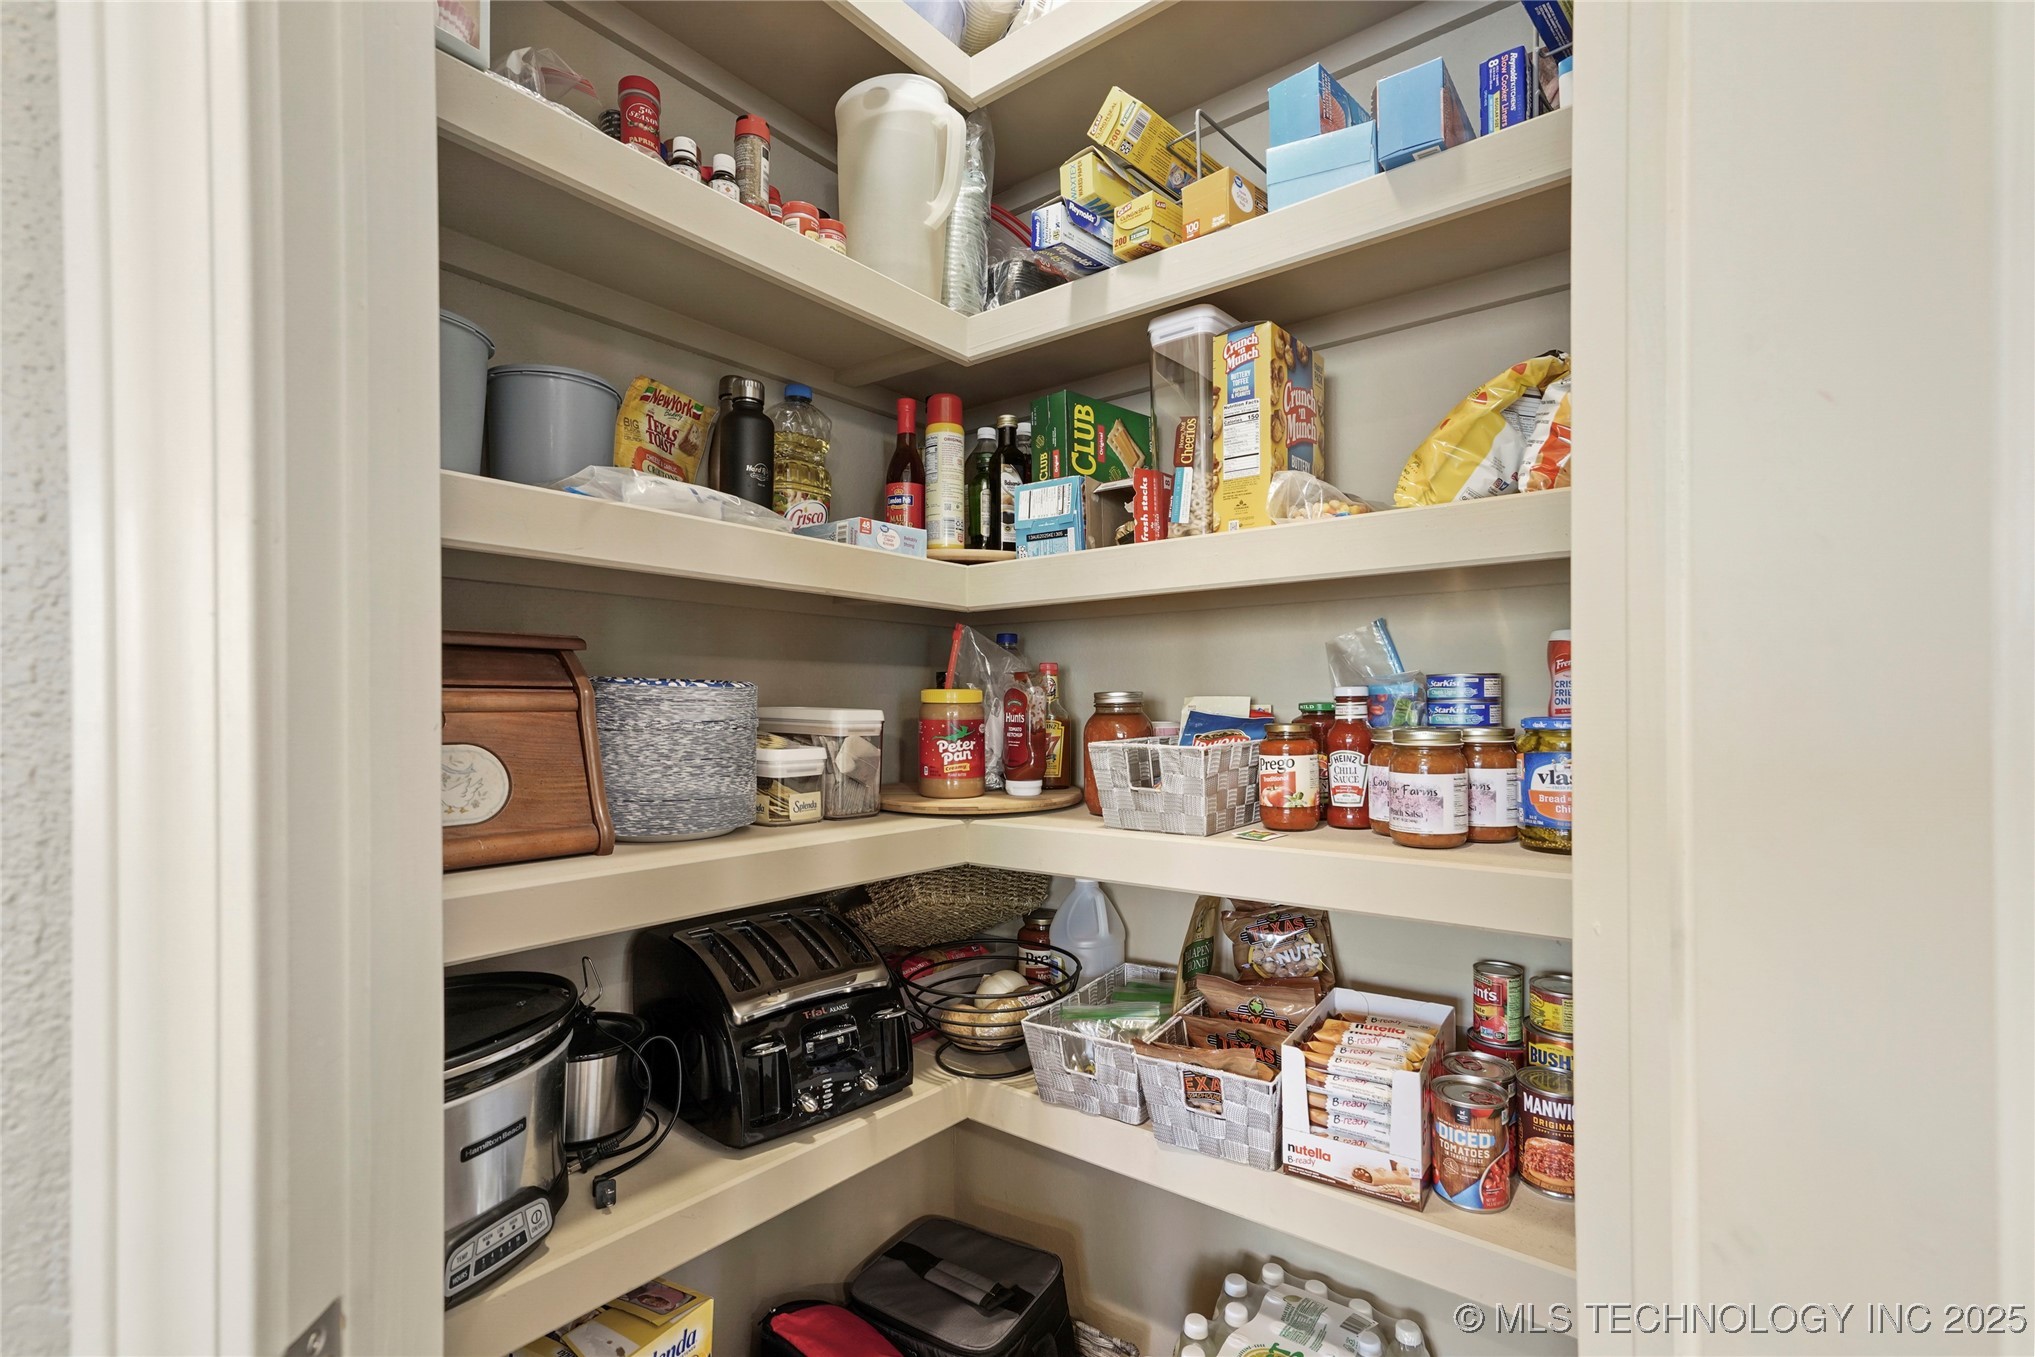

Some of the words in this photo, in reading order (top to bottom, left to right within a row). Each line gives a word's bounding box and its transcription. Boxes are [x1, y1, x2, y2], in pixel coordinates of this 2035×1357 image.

[1488, 58, 1498, 68] 8
[1501, 54, 1509, 73] Slow
[1501, 75, 1509, 102] Cooker
[629, 110, 658, 126] SEASON
[1501, 102, 1509, 127] Liners
[1092, 115, 1102, 135] GLAD
[1109, 129, 1121, 146] 200
[1069, 202, 1095, 223] Reynolds
[1117, 202, 1132, 216] GLAD
[1186, 222, 1198, 234] 100
[1114, 236, 1127, 248] 200
[1224, 333, 1258, 359] Crunch
[1226, 347, 1258, 373] Munch
[1232, 377, 1250, 386] TOFFEE
[1284, 382, 1316, 413] Crunch
[624, 417, 640, 428] BIG
[646, 413, 679, 442] TEXAS
[1286, 413, 1316, 444] Munch
[646, 430, 676, 456] TOAST
[1071, 403, 1097, 476] CLUB
[1180, 418, 1197, 464] Cheerios
[746, 464, 762, 472] Hard
[1039, 452, 1048, 481] CLUB
[1292, 454, 1310, 473] BUTTERY
[1140, 477, 1148, 511] stacks
[790, 508, 824, 529] Crisco
[862, 521, 870, 529] 48
[1140, 514, 1149, 542] fresh
[1430, 680, 1464, 688] StarKist
[1554, 698, 1571, 706] ONI
[1434, 706, 1468, 714] StarKist
[936, 740, 976, 753] Peter
[1260, 758, 1296, 774] Prego
[1334, 754, 1358, 764] HEINZ
[946, 764, 967, 772] Creamy
[1334, 766, 1358, 775] CHILI
[1334, 776, 1360, 784] SAUCE
[1401, 784, 1438, 797] Farms
[1538, 794, 1566, 803] Bread
[792, 800, 818, 813] Splenda
[1404, 809, 1424, 818] Salsa
[1556, 806, 1572, 814] Chi
[1248, 918, 1305, 941] TEXAS
[1026, 952, 1050, 966] Pre
[1188, 956, 1210, 973] HONEY
[1356, 1024, 1406, 1034] nutella
[1348, 1036, 1381, 1046] B-ready
[1340, 1047, 1375, 1056] B-ready
[1530, 1046, 1573, 1070] BUSH'
[1335, 1057, 1371, 1067] B-ready
[1332, 1097, 1368, 1110] B-ready
[1333, 1114, 1369, 1127] B-ready
[1533, 1116, 1574, 1132] ORIGINA
[464, 1136, 502, 1158] Hamilton
[502, 1122, 524, 1139] Beach
[1438, 1121, 1491, 1149] DICED
[1288, 1143, 1332, 1162] nutella
[1439, 1138, 1490, 1158] TOMATOES
[1288, 1156, 1316, 1166] B-ready
[457, 1252, 469, 1264] TEMP
[452, 1270, 468, 1286] HOURS
